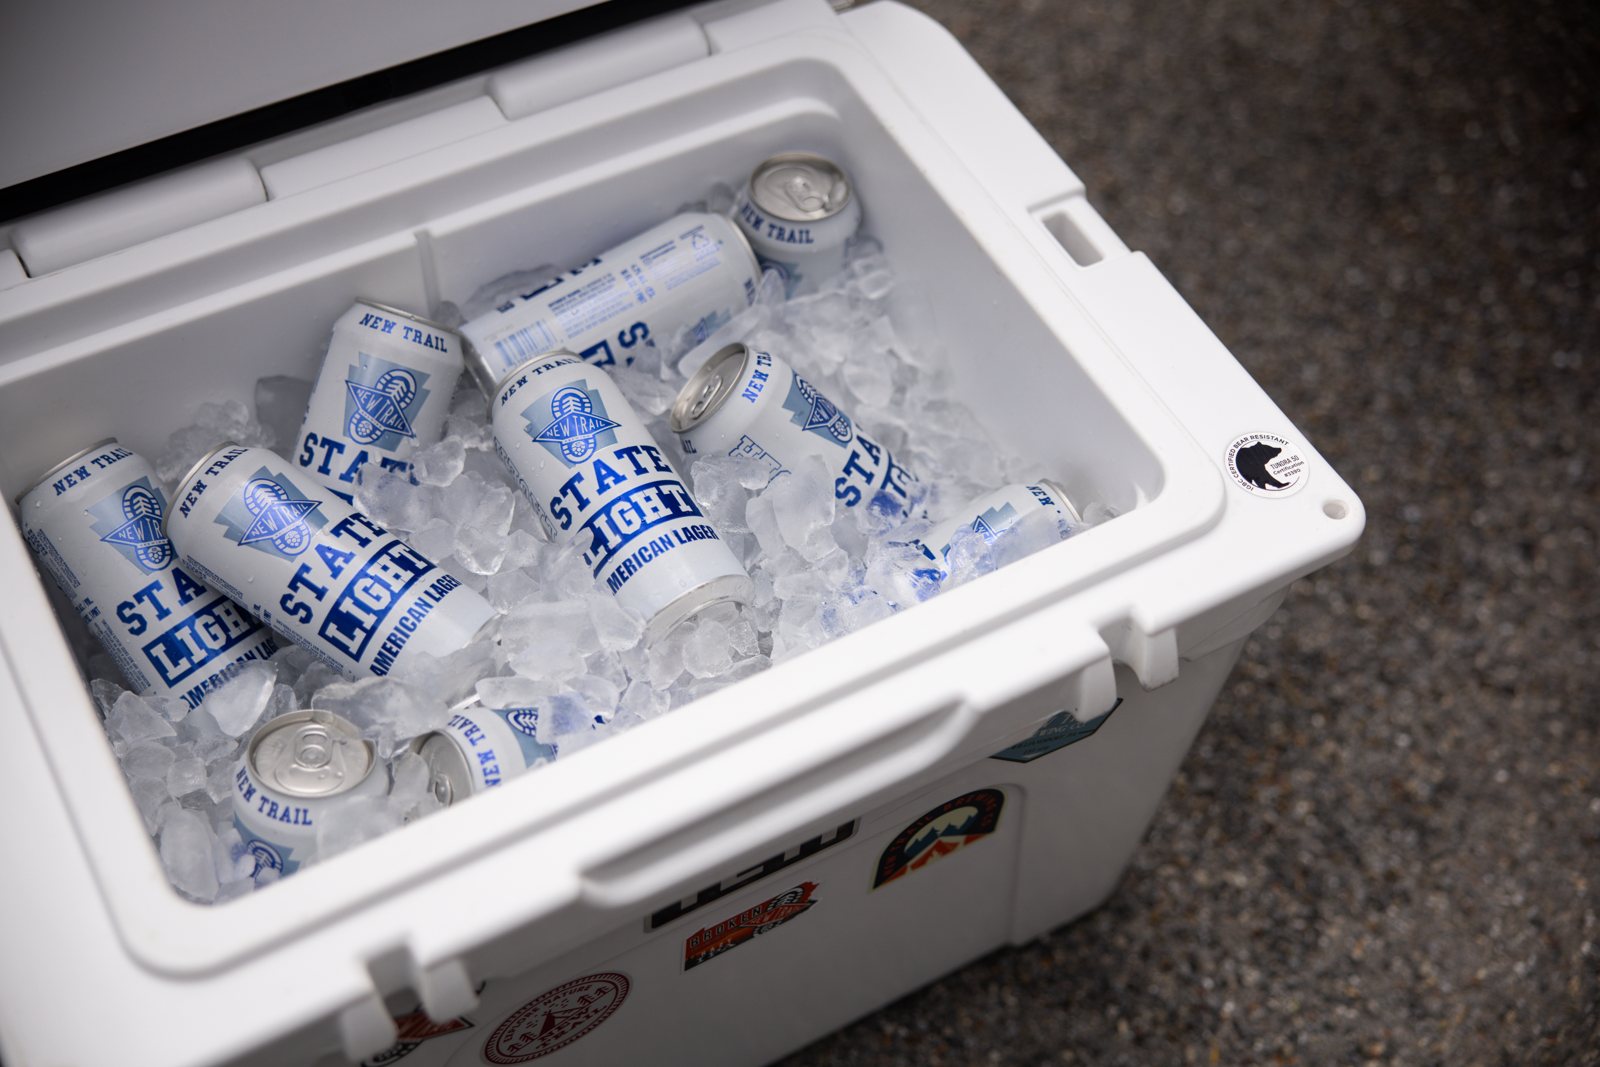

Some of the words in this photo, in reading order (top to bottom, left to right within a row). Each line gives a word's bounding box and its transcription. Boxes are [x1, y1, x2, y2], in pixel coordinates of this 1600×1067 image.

[742, 203, 764, 231] NEW
[767, 223, 814, 244] TRAIL
[359, 313, 396, 334] NEW
[403, 326, 448, 353] TRAIL
[501, 375, 528, 406] NEW
[742, 369, 769, 403] NEW
[356, 389, 383, 412] NEW
[374, 399, 404, 429] TRAIL
[547, 418, 570, 437] NEW
[572, 415, 606, 436] TRAIL
[1233, 437, 1249, 449] BEAR
[1250, 434, 1289, 446] RESISTANT
[52, 466, 91, 496] NEW
[91, 447, 133, 469] TRAIL
[179, 480, 207, 518] NEW
[205, 449, 248, 476] TRAIL
[835, 434, 881, 508] STA
[1228, 448, 1238, 479] CERTIFIED
[1270, 458, 1292, 469] TUNDRA
[1273, 461, 1304, 475] Certification
[550, 445, 673, 531] STATE
[1026, 486, 1055, 506] NEW
[1238, 479, 1254, 491] IGBC
[118, 521, 145, 541] NEW
[251, 512, 278, 536] NEW
[273, 503, 308, 527] TRAIL
[280, 512, 388, 624] STATE
[606, 534, 676, 596] MERICAN
[672, 525, 720, 544] LAGER
[116, 566, 208, 636] STA
[325, 545, 430, 656] LIGHT
[150, 600, 251, 680] LIGH
[254, 637, 280, 660] LAG
[369, 596, 434, 677] AMERICAN
[448, 714, 486, 747] TRAIL
[236, 766, 256, 803] NEW
[258, 795, 312, 826] TRAIL
[690, 905, 762, 949] BROKEN
[504, 1008, 538, 1042] EXPLORE
[544, 985, 592, 1005] NATURE
[536, 1006, 607, 1049] TRAIL
